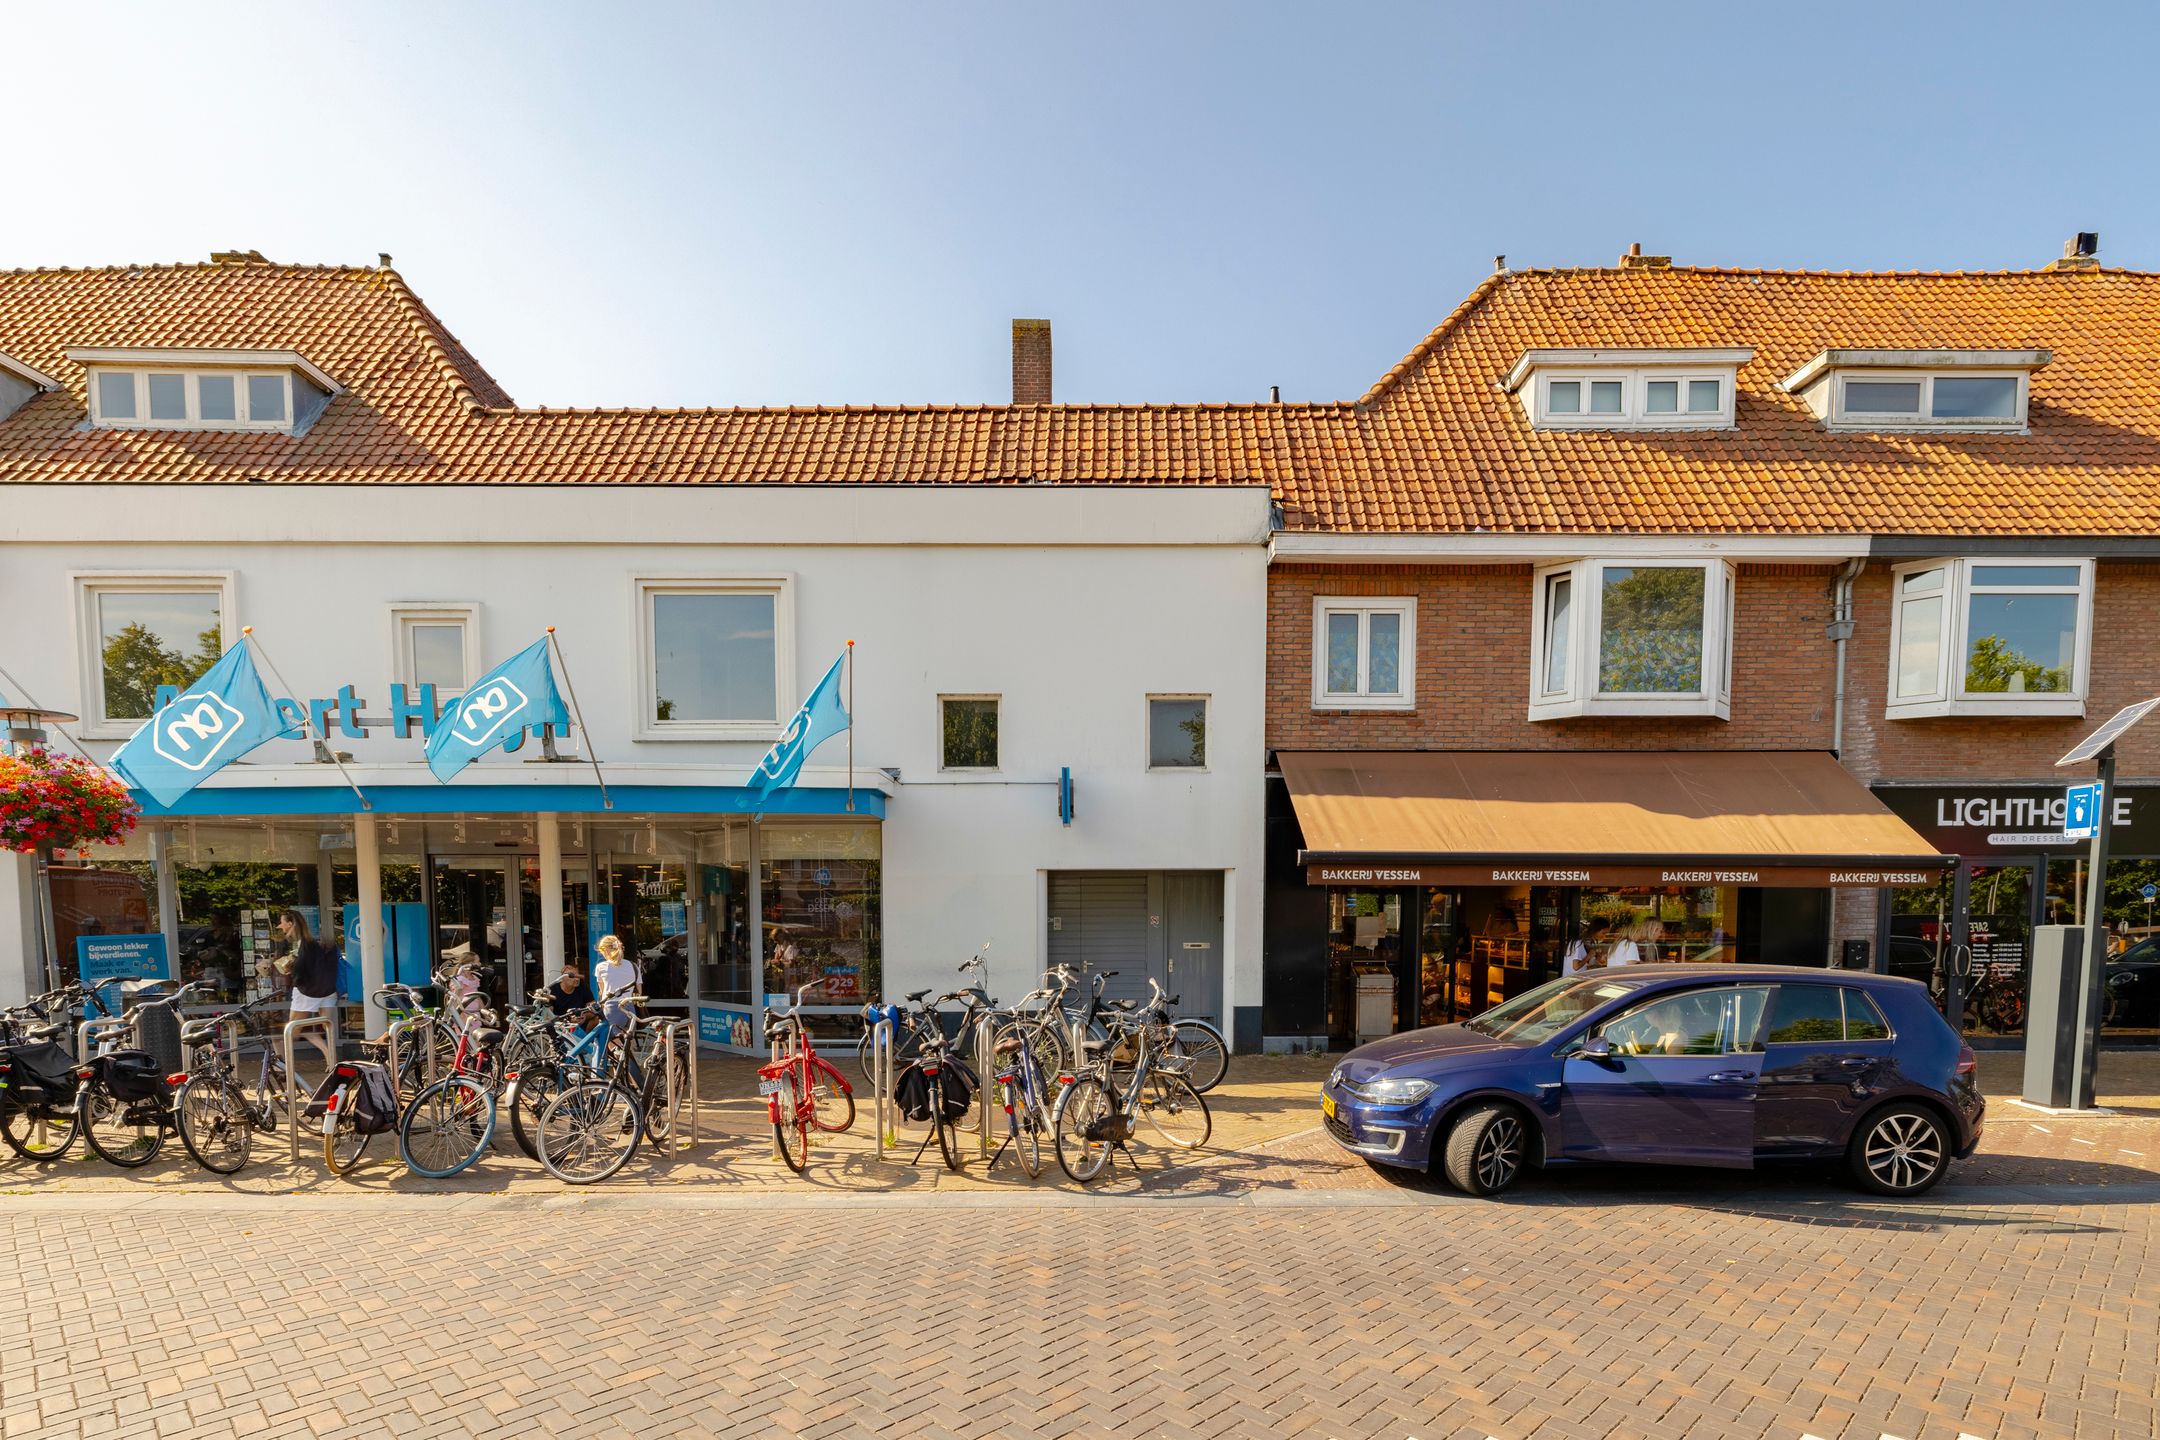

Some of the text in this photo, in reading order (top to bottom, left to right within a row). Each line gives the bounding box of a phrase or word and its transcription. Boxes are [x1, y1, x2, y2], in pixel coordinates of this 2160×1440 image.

[1937, 798, 2132, 826] LIGHTHOE
[1322, 869, 1421, 880] BAKKERIJ VESSEM
[1492, 870, 1590, 881] BAKKERIJ VESSEM
[1662, 871, 1759, 882] BAKKERIJ VESSEM
[1829, 872, 1927, 883] BAKKERIJ VESSEM
[88, 942, 149, 952] Gewoon lekker
[88, 951, 141, 960] bijverdienen.
[90, 960, 114, 968] Maak
[91, 967, 114, 976] werk
